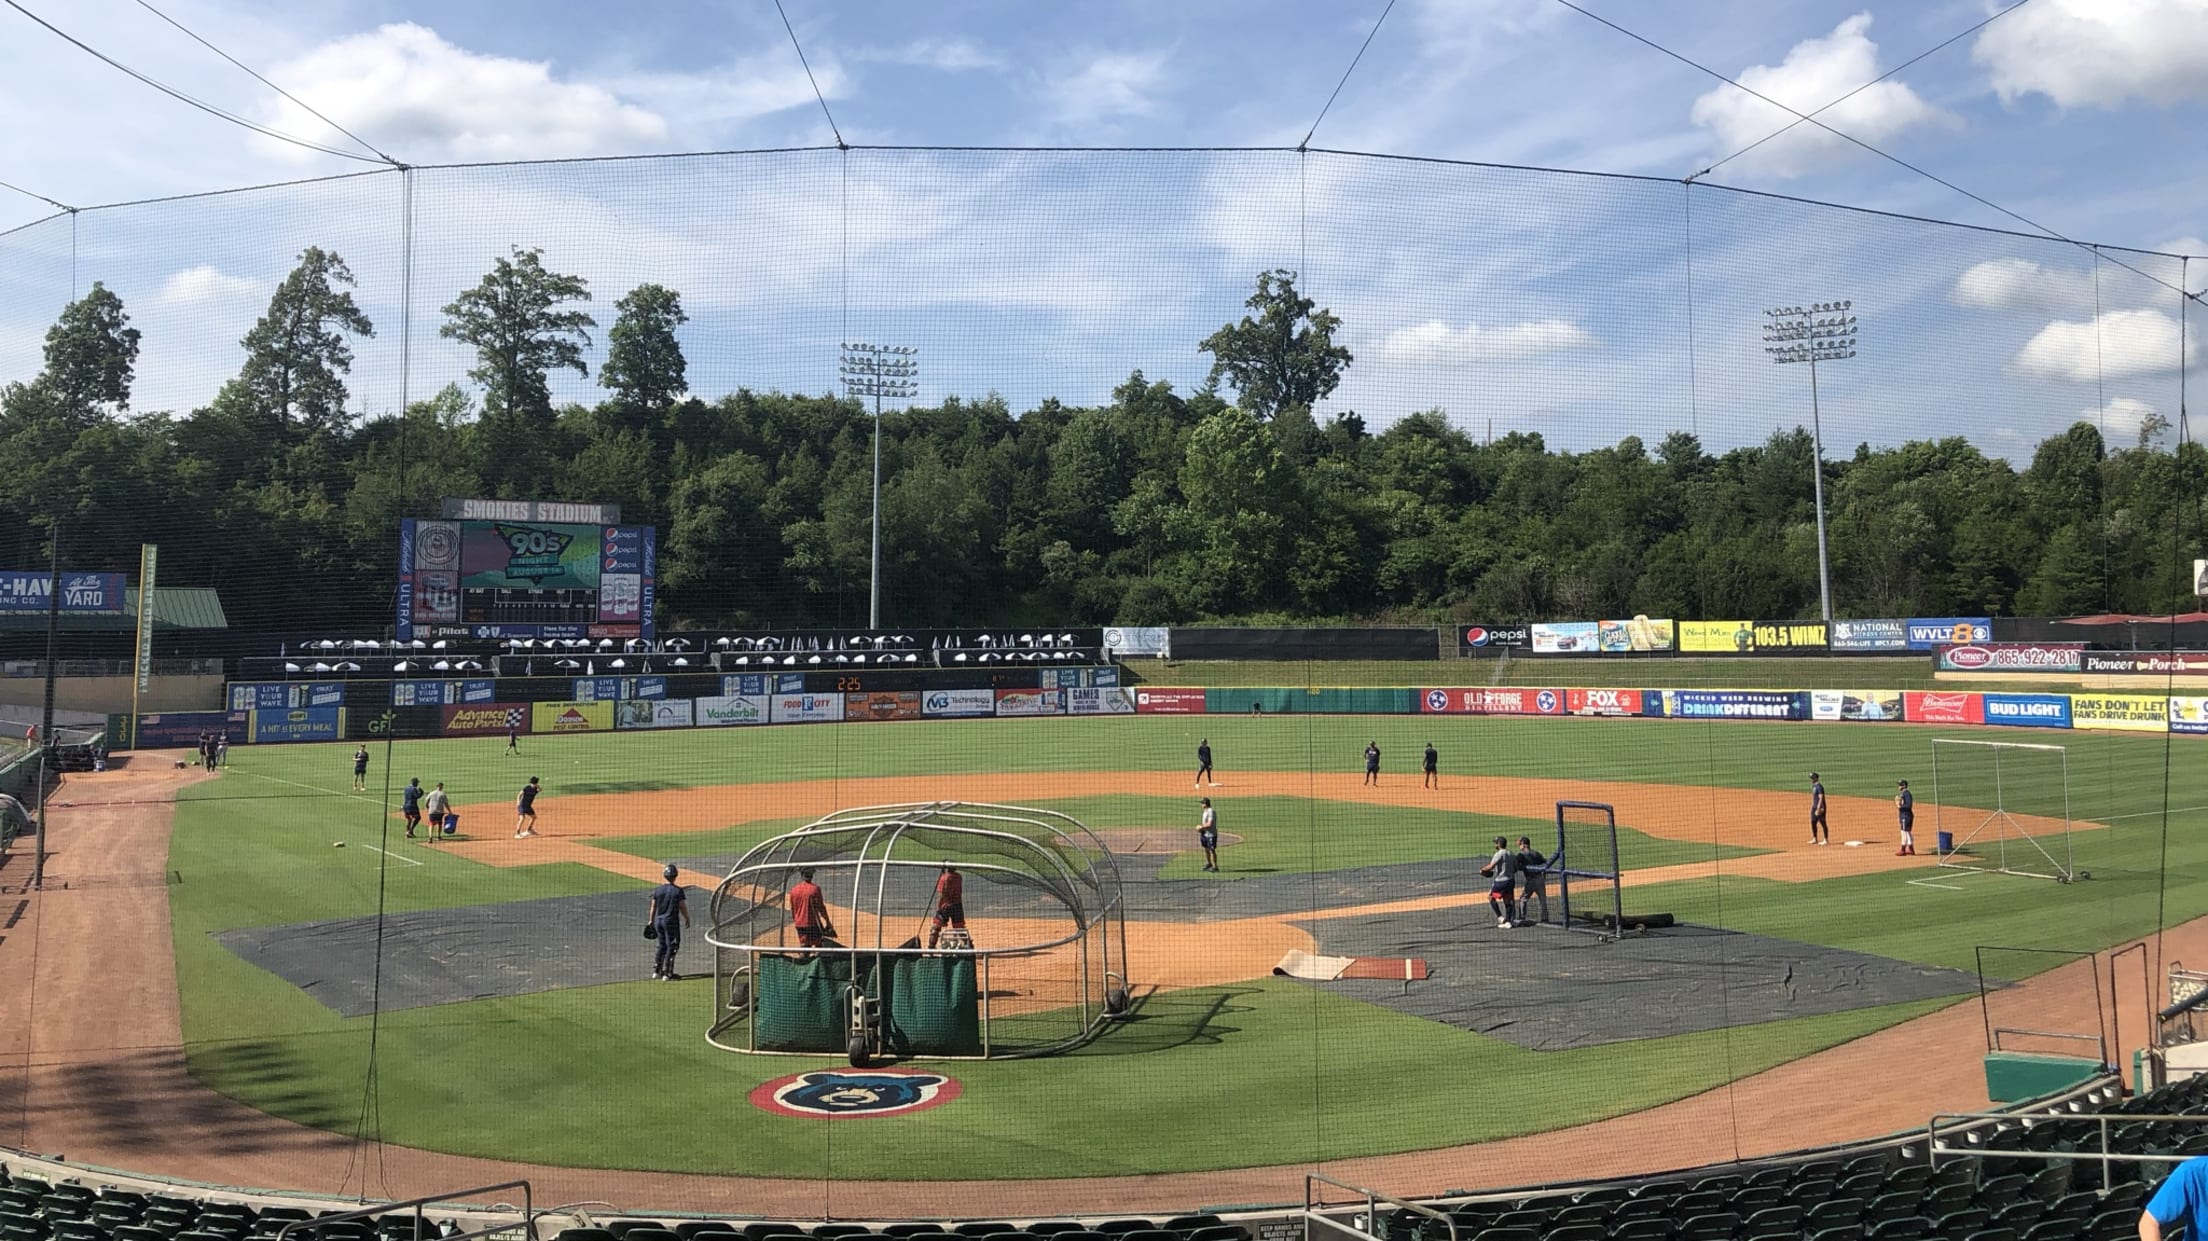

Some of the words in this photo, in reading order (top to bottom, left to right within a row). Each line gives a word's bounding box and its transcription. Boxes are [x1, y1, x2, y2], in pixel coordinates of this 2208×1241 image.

[464, 500, 529, 520] SMOKIES
[537, 504, 601, 521] STADIUM
[618, 529, 638, 538] pepsi
[510, 532, 561, 554] 90's
[618, 545, 637, 554] pepsi
[618, 560, 637, 569] pepsi
[64, 591, 103, 606] YARD
[400, 584, 411, 627] ULTRA
[643, 586, 653, 625] ULTRA
[1853, 623, 1902, 631] NATIONAL
[1490, 629, 1527, 640] pepsi
[1754, 626, 1788, 646] 103.5
[1789, 625, 1827, 646] WIMZ
[1912, 628, 1952, 639] WVLT
[1952, 624, 1973, 644] 8
[1953, 650, 1987, 661] Pioneer
[2086, 658, 2134, 670] Pioneer
[2148, 658, 2186, 670] Porch
[951, 696, 990, 704] Technology
[1072, 689, 1099, 700] GAMES
[1464, 692, 1482, 704] OLD
[1494, 693, 1522, 704] FORGE
[1586, 690, 1618, 706] FOX
[784, 700, 802, 709] FOOD
[814, 700, 830, 708] CITY
[1924, 696, 1964, 708] Budweiser
[2075, 700, 2102, 710] FANS
[2105, 700, 2140, 711] DON'T
[2144, 702, 2165, 712] LET
[452, 709, 505, 721] Advance
[706, 708, 759, 719] Vanderbilt
[1989, 703, 2019, 716] BUD
[2020, 704, 2061, 717] LIGHT
[2074, 710, 2098, 719] FANS
[2099, 711, 2128, 720] DRIVE
[2130, 712, 2166, 722] DRUNK
[119, 716, 128, 742] 330
[289, 724, 312, 732] EVERY
[313, 723, 334, 732] MEAL
[446, 719, 474, 729] Auto
[474, 718, 504, 728] Parts
